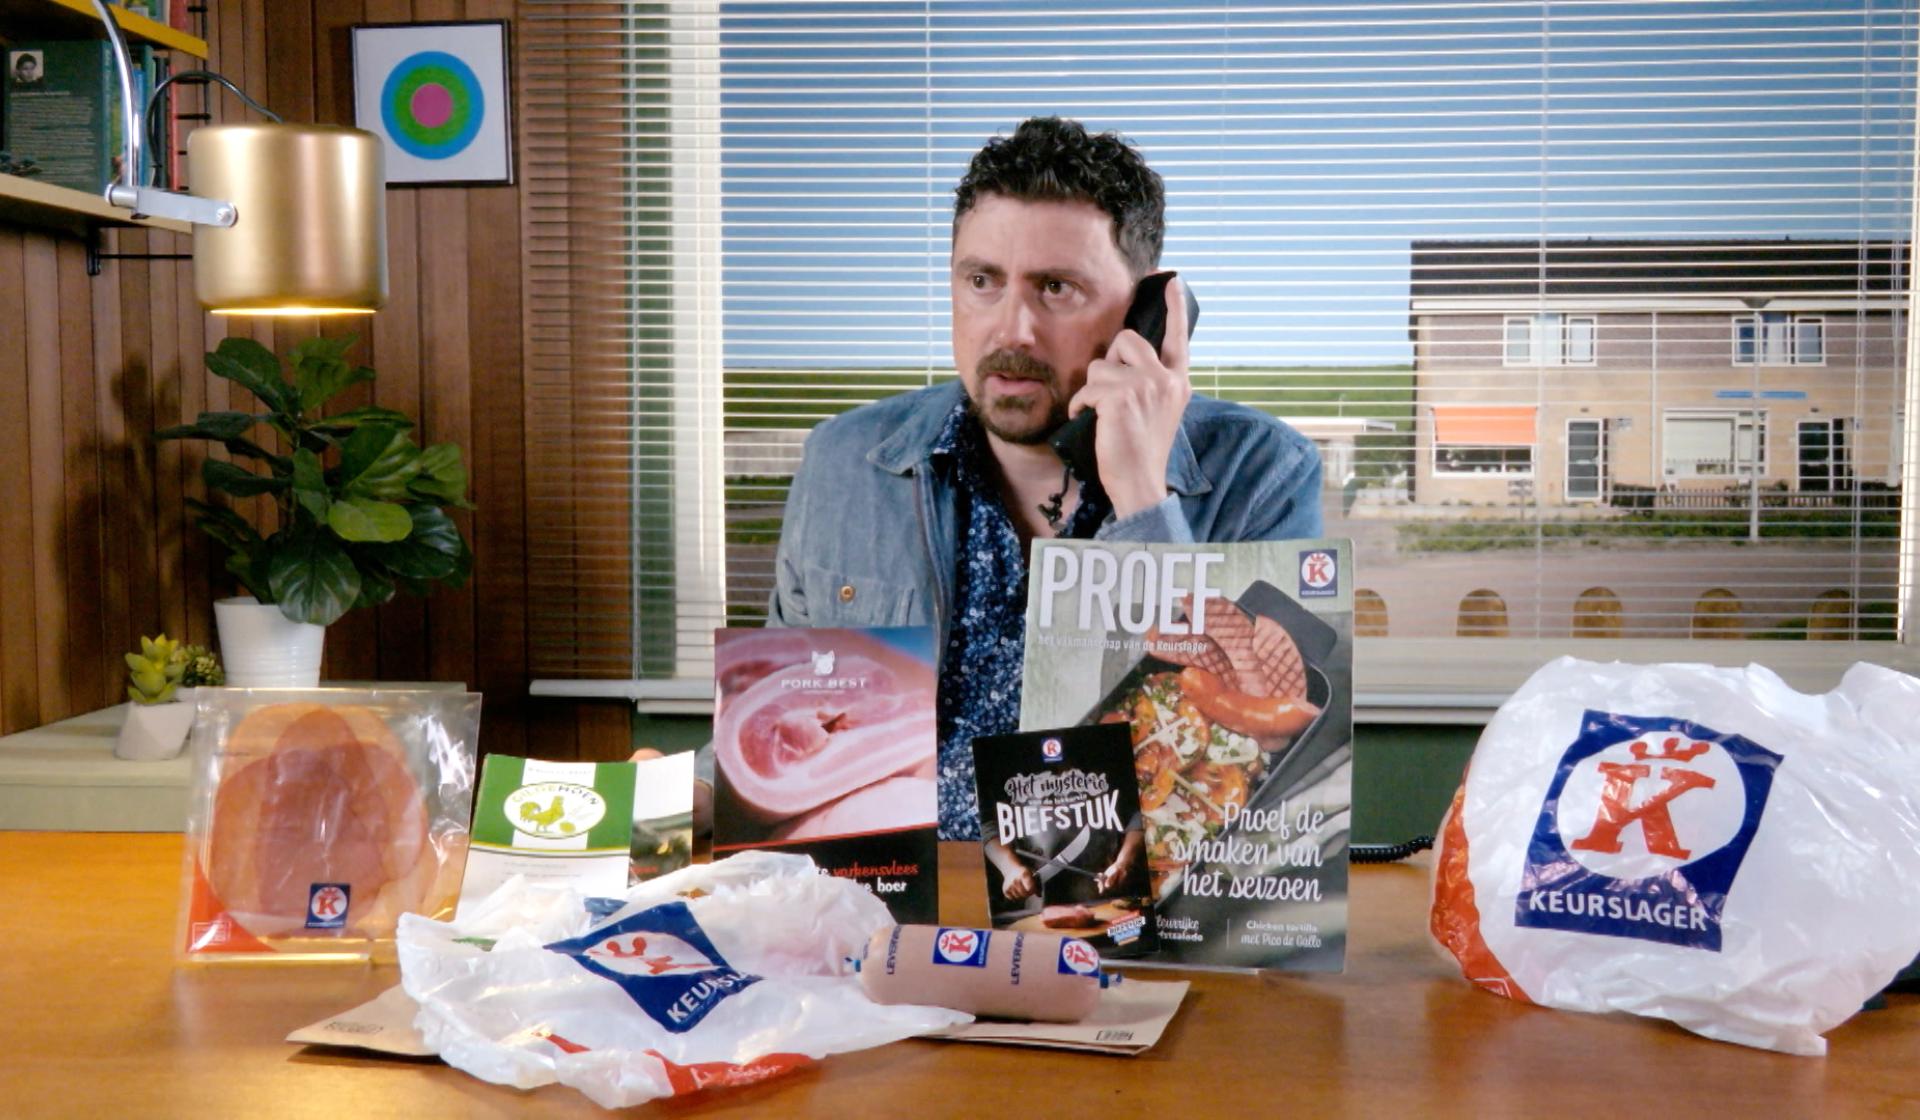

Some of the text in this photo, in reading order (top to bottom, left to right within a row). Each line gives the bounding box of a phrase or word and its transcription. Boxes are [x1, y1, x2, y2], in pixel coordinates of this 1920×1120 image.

[1039, 547, 1225, 635] PROEF
[1056, 636, 1121, 652] vakmanschap
[1123, 640, 1141, 650] van
[1143, 640, 1155, 651] de
[1157, 639, 1208, 654] Keurslager
[780, 678, 867, 689] PORK BEST
[1007, 775, 1034, 801] Het
[1040, 770, 1105, 793] mysterie
[996, 789, 1124, 846] BIEFSTUK
[1223, 800, 1324, 840] Proef de
[1171, 835, 1324, 868] smaken van
[833, 860, 919, 876] varkensvlees
[1183, 864, 1322, 903] het seizoen
[877, 877, 908, 893] boer
[1246, 919, 1285, 932] Chicken
[1529, 890, 1708, 932] KEURSLAGER
[1241, 934, 1260, 945] met
[1283, 934, 1294, 946] de
